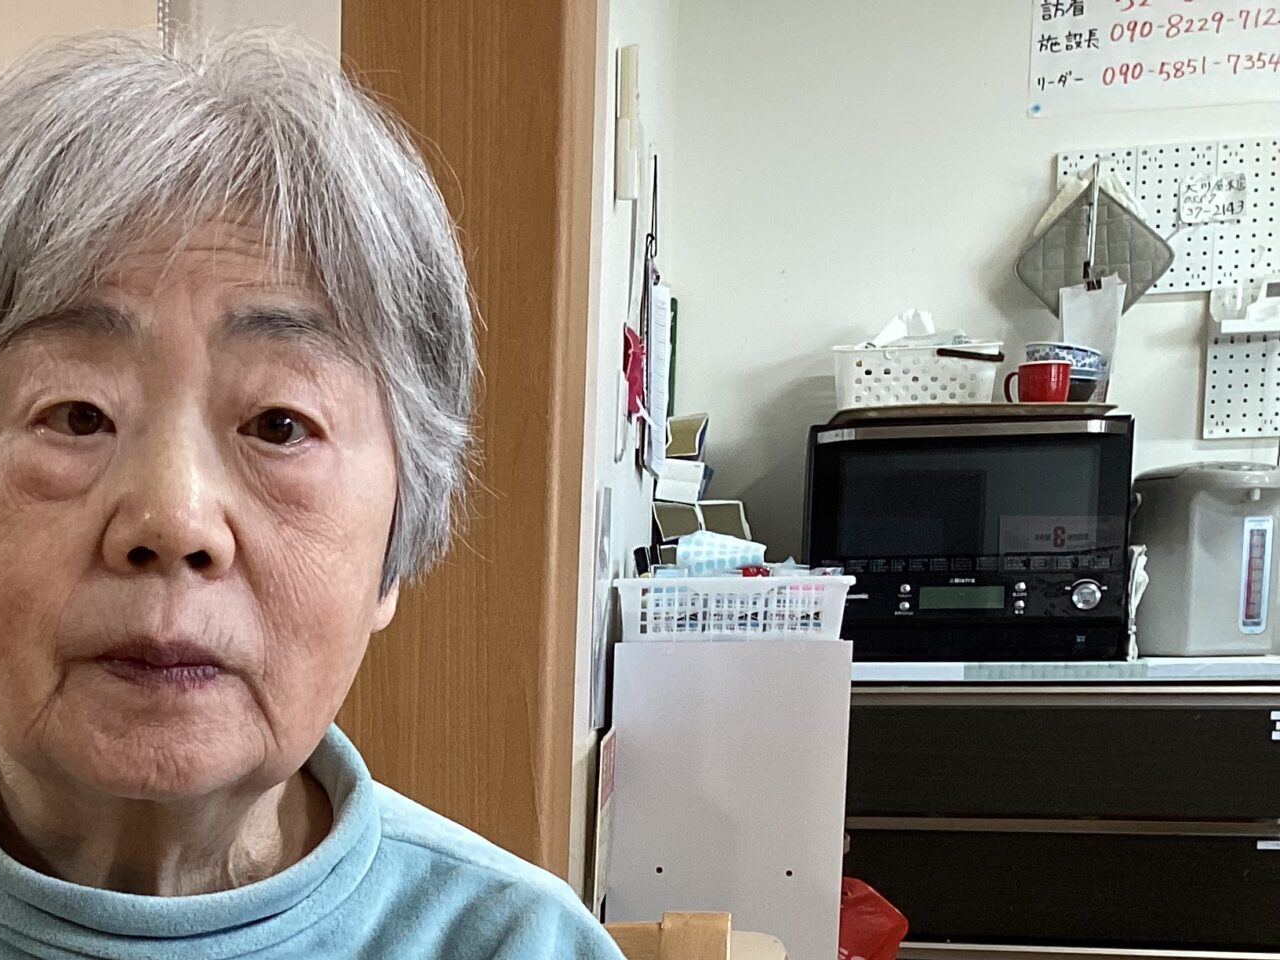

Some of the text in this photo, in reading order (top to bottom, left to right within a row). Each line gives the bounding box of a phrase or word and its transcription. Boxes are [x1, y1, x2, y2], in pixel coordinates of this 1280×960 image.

[1038, 8, 1280, 53] 施設長 090-8229-712
[1038, 52, 1280, 91] リーダー 090-5851-7354
